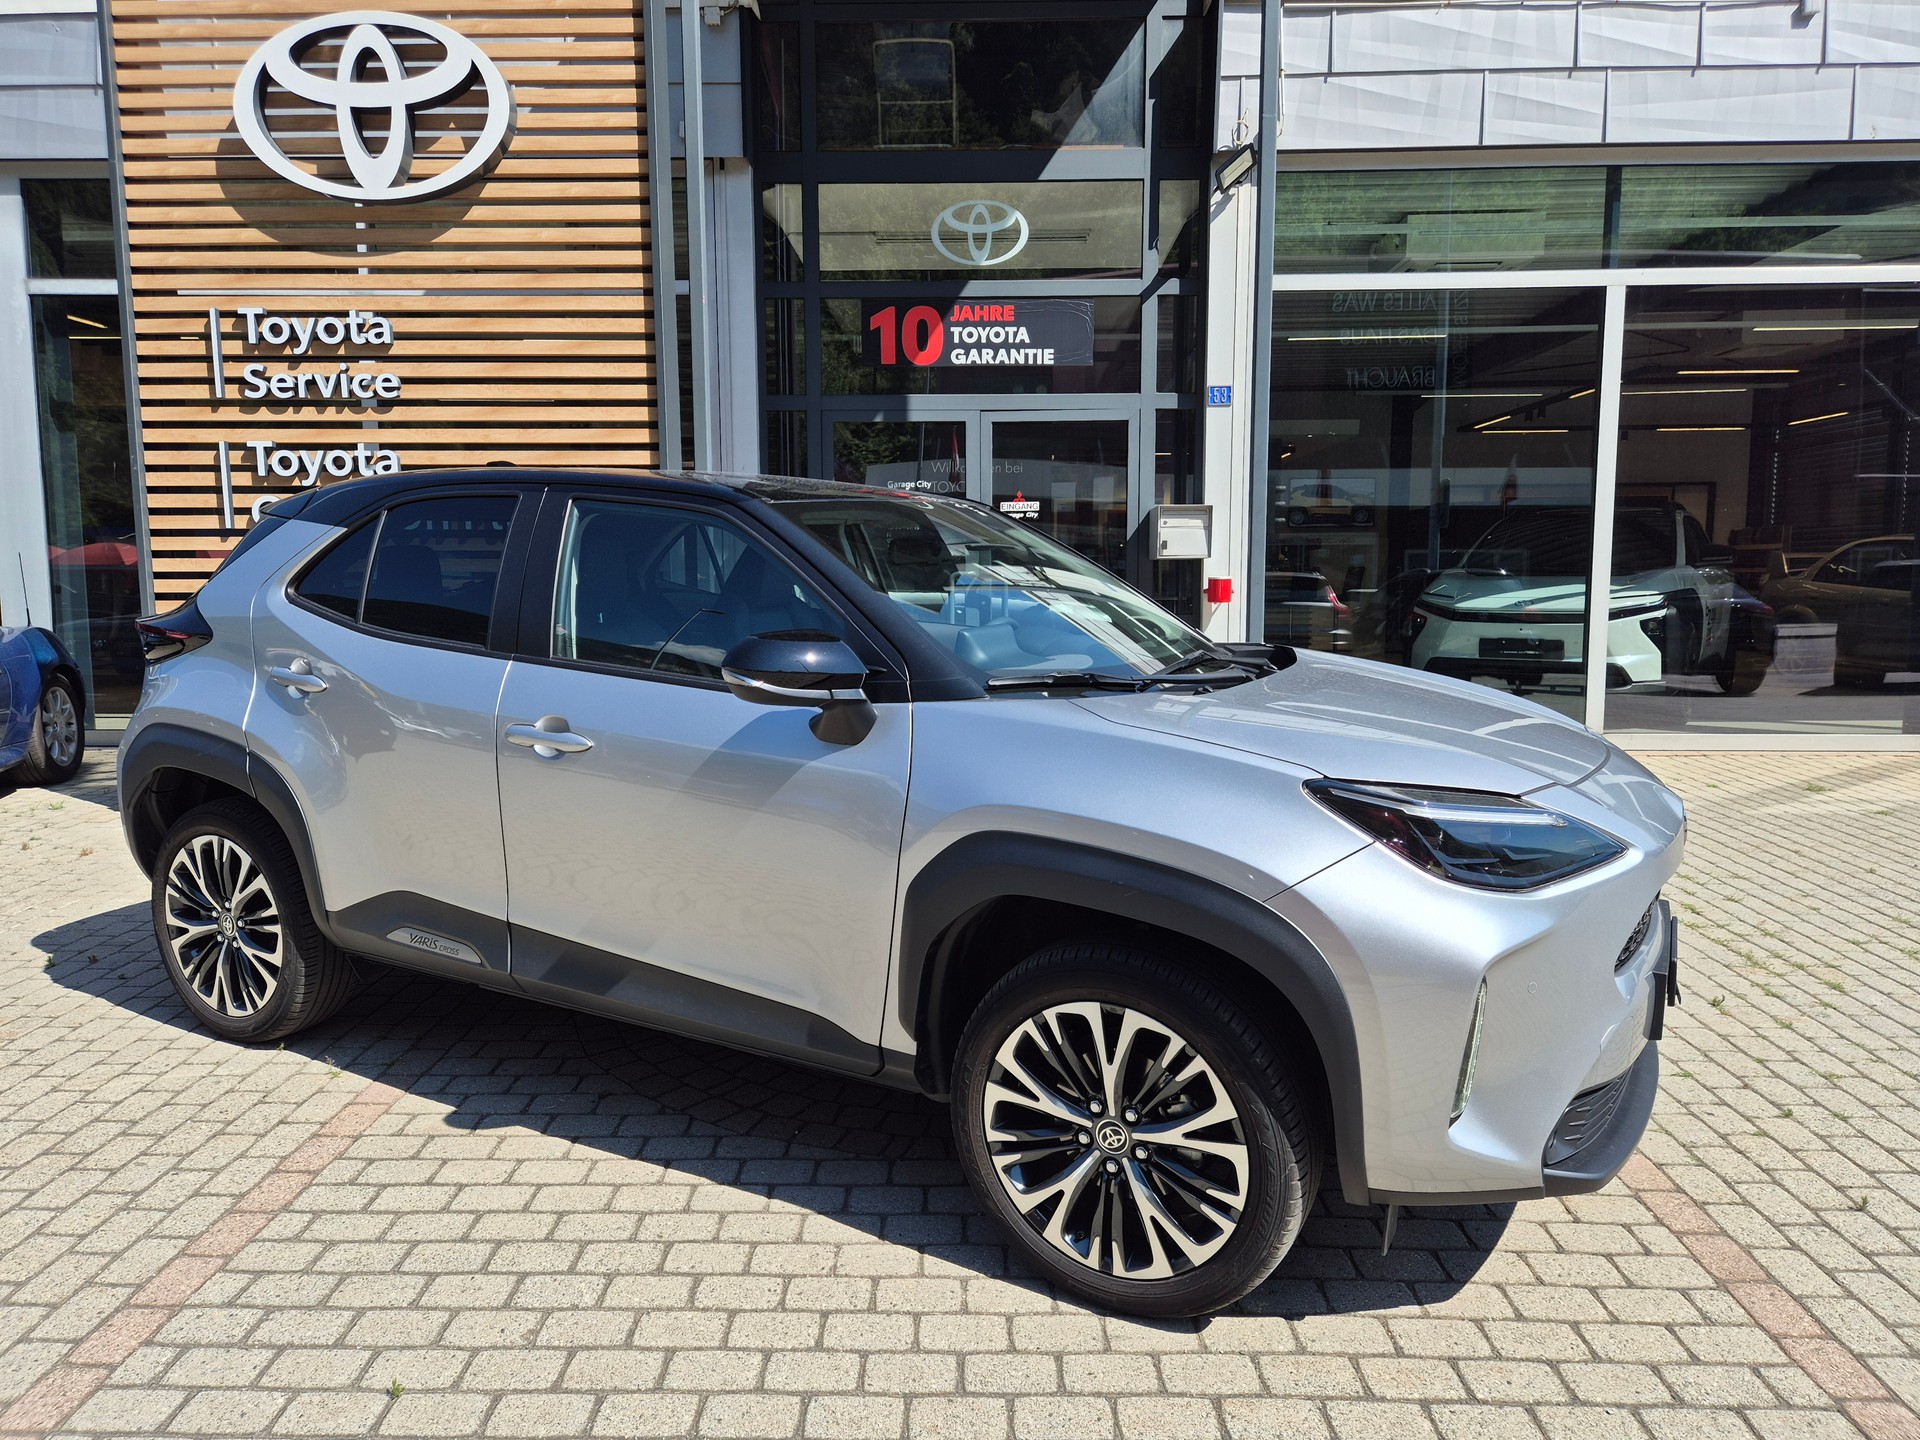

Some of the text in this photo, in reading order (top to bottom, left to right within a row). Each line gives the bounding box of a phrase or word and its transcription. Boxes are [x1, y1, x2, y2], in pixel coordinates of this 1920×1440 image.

[950, 304, 1015, 322] JAHRE
[237, 306, 394, 354] Toyota
[869, 305, 944, 366] 10
[950, 326, 1030, 344] TOYOTA
[950, 347, 1055, 366] GARANTIE
[243, 361, 401, 400] Service
[246, 440, 400, 486] Toyota
[1005, 460, 1024, 473] bei
[887, 480, 932, 491] Garage City
[1025, 511, 1039, 519] City
[410, 933, 460, 955] YARIS CROSS
